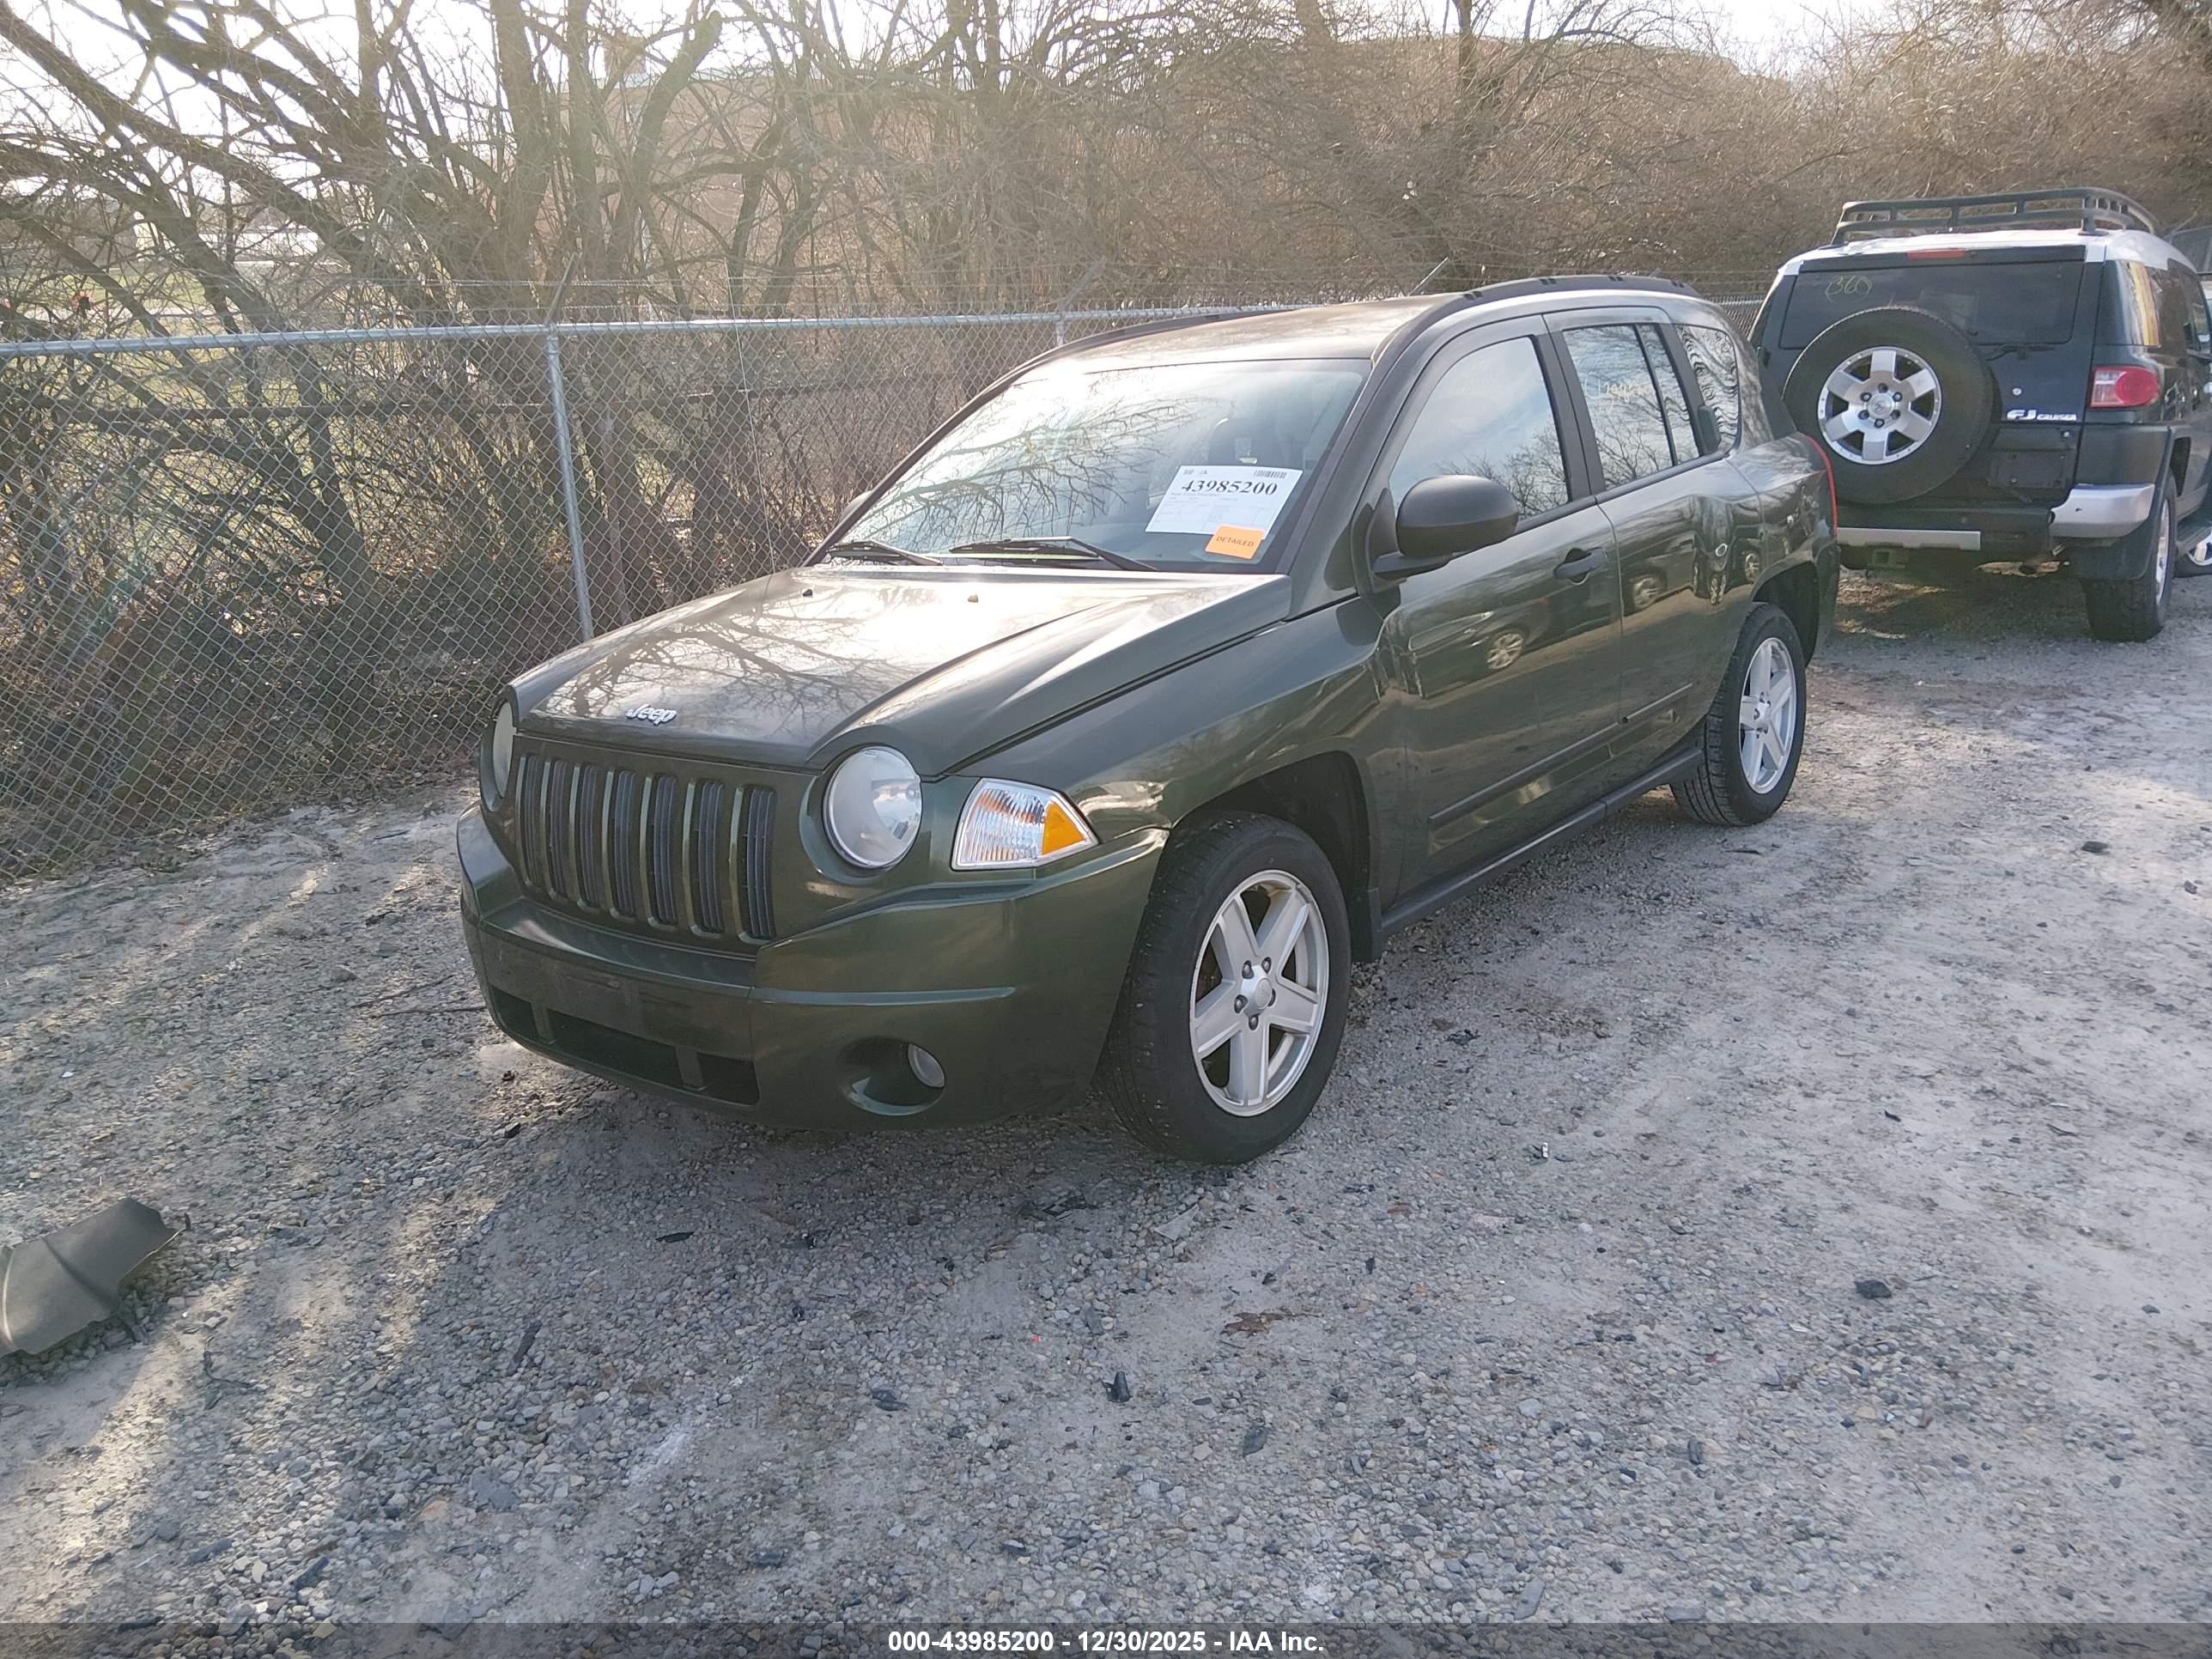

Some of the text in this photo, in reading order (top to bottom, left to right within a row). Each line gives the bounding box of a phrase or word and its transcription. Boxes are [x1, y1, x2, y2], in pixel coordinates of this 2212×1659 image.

[2007, 410, 2037, 421] FJ
[1182, 480, 1277, 495] 43985200
[1216, 536, 1255, 547] DETAILED
[626, 703, 677, 726] Jeep
